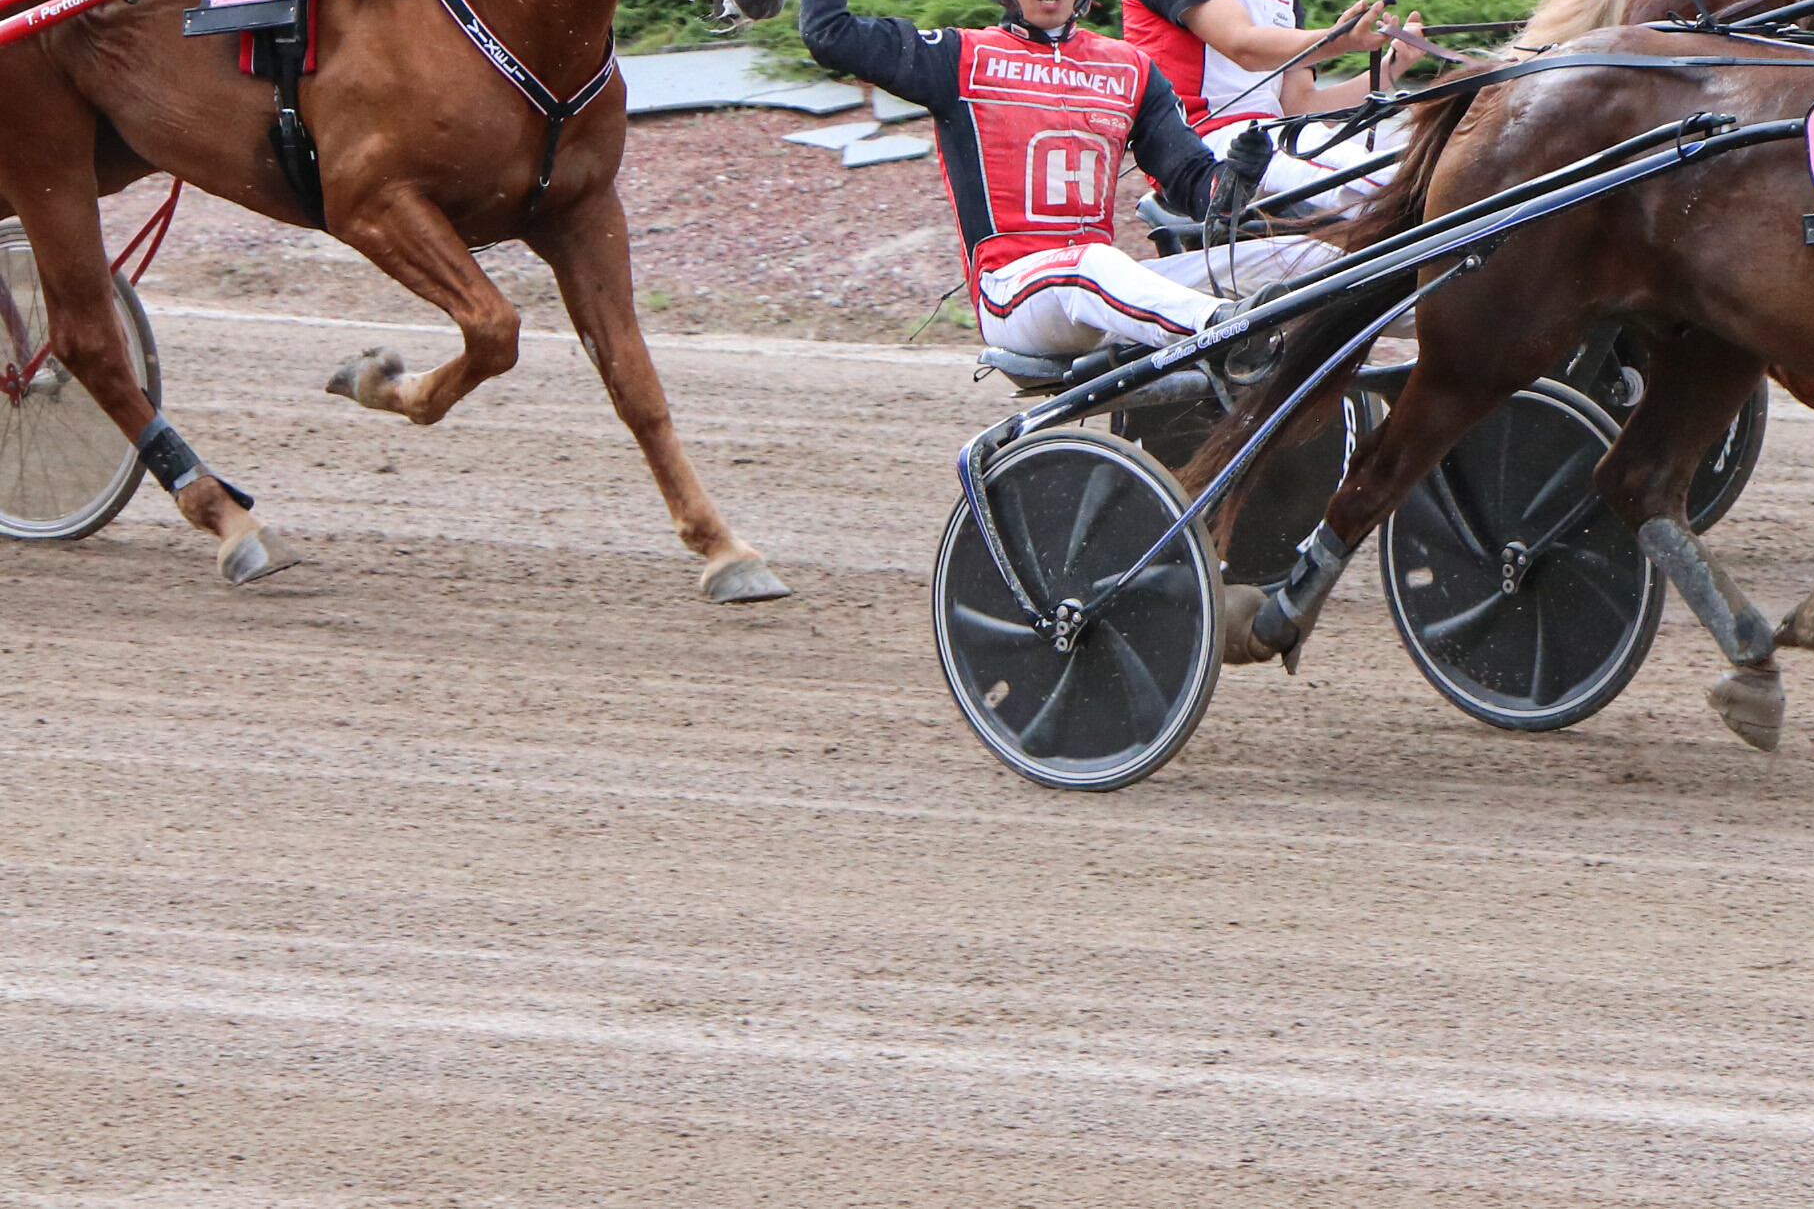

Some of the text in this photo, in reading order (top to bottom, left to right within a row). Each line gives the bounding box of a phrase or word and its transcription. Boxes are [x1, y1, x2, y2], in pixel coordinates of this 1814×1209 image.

[25, 12, 38, 26] T.
[466, 18, 526, 82] VIXELI
[985, 57, 1126, 96] HEIKKINEN
[1046, 149, 1099, 205] H
[1197, 319, 1250, 349] Chrono
